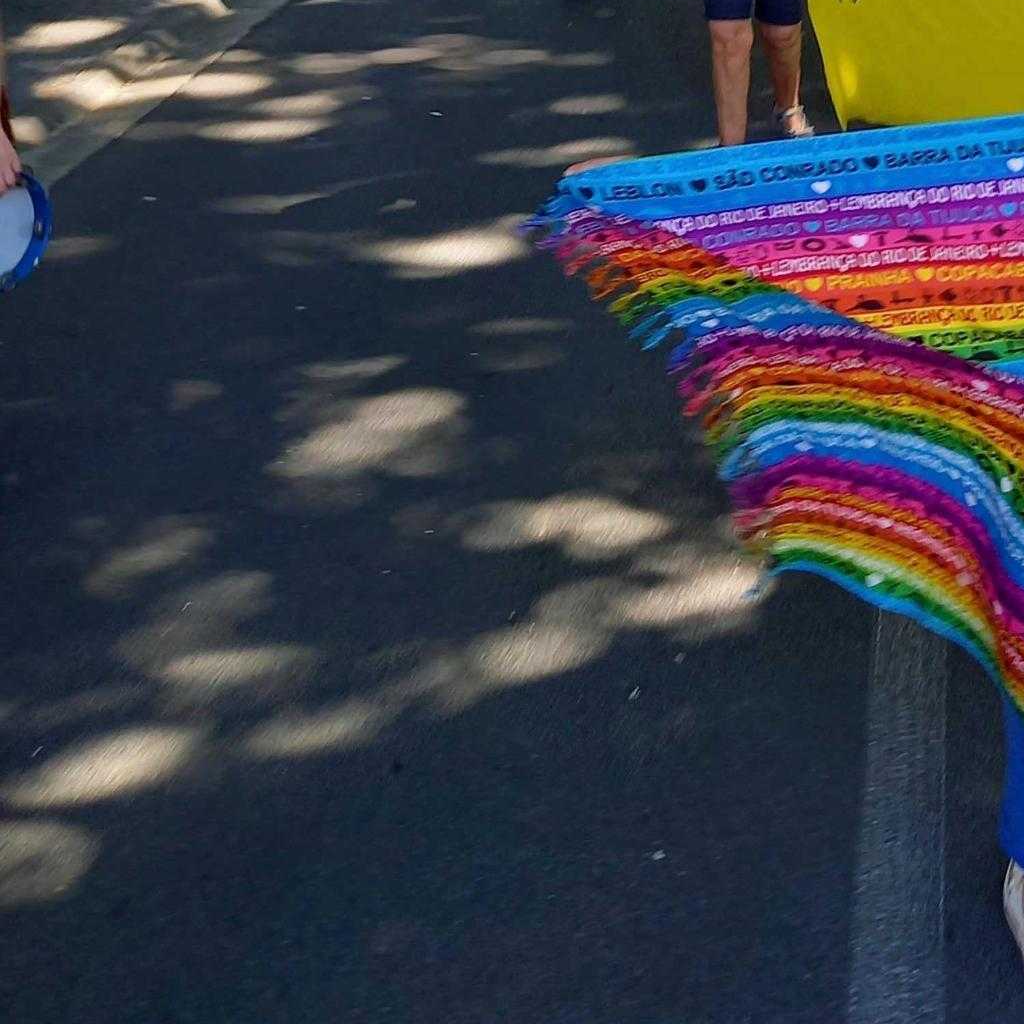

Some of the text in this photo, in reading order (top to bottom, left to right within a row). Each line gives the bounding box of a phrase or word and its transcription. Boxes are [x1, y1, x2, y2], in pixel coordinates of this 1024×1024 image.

[603, 180, 683, 201] LEBLON
[760, 154, 857, 185] CONRADO
[884, 146, 950, 169] BARRA
[956, 142, 982, 161] DA
[694, 211, 718, 229] DO
[719, 207, 745, 225] RIO
[746, 205, 770, 222] DE
[927, 185, 950, 203] DO
[951, 182, 976, 200] RIO
[976, 180, 999, 198] DE
[702, 220, 801, 249] CONRADO
[824, 213, 893, 233] BARRA
